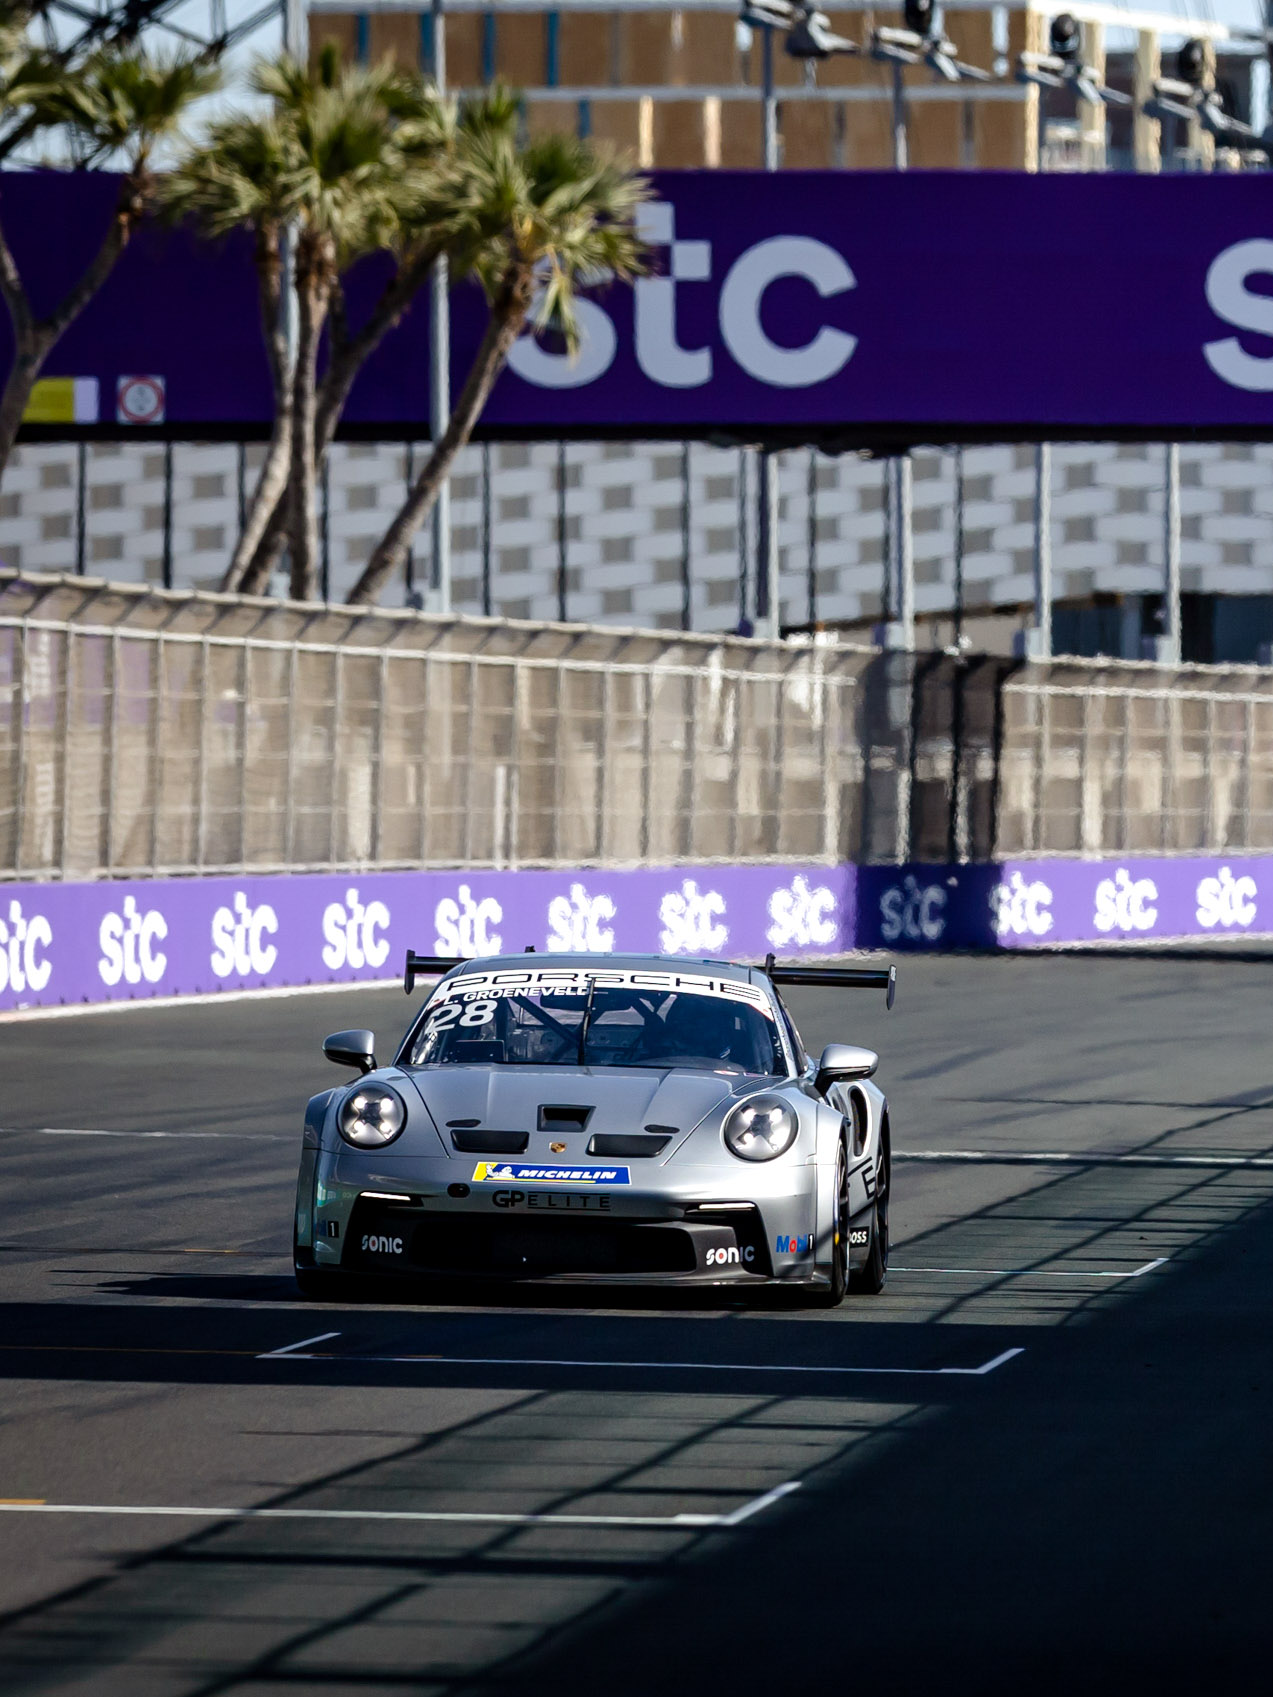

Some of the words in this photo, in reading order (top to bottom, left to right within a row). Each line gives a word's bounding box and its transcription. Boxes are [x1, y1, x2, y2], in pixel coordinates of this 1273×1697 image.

[504, 200, 859, 389] stc
[321, 887, 391, 970] stc
[434, 884, 503, 958] stc
[547, 883, 617, 952] stc
[660, 879, 729, 955] stc
[767, 874, 838, 949] stc
[879, 875, 947, 941] stc
[989, 870, 1054, 936] stc
[1094, 867, 1159, 932] stc
[1196, 865, 1258, 927] stc
[98, 895, 168, 986] stc
[210, 891, 278, 977] stc
[424, 1000, 498, 1035] 28
[447, 972, 760, 1001] PORSCHE
[462, 986, 590, 1003] GROENEVELD
[517, 1169, 617, 1180] MICHELIN
